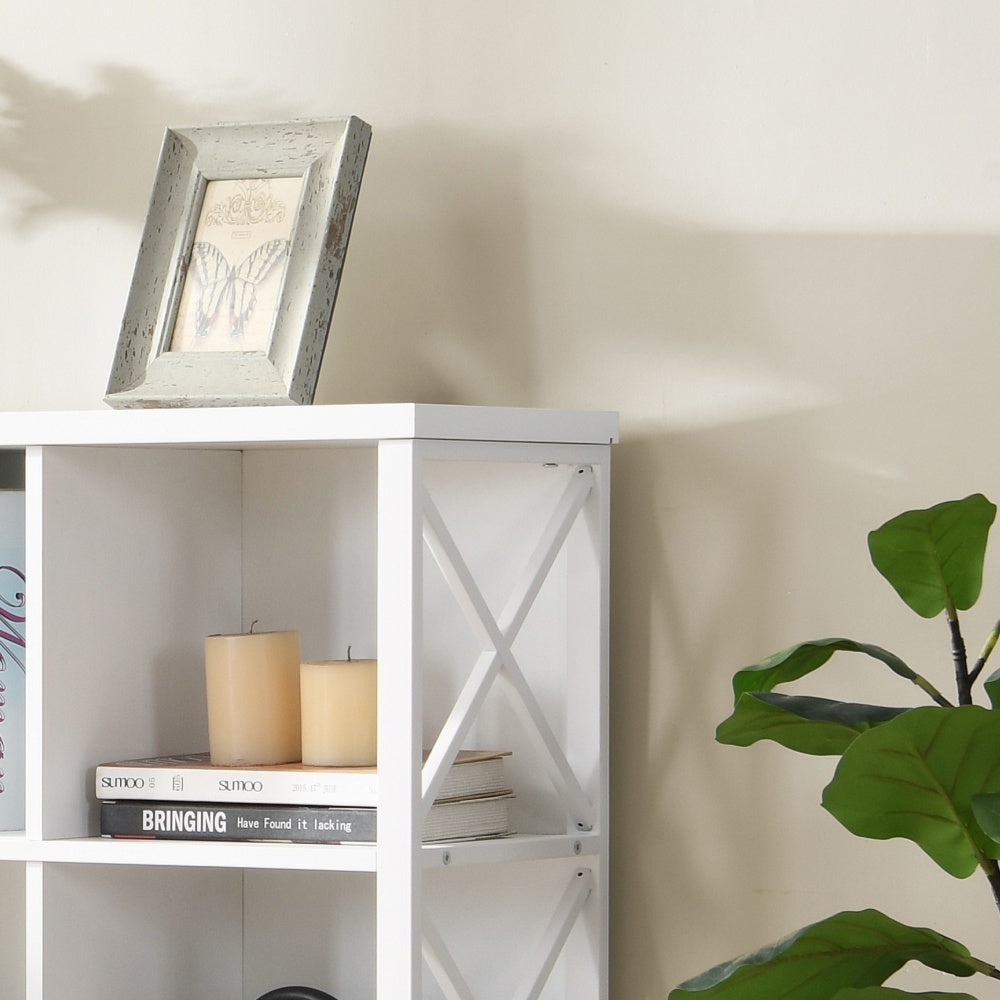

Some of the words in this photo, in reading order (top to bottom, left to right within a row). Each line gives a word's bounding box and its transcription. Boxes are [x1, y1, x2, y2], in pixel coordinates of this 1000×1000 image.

[142, 809, 227, 833] BRINGING
[237, 817, 259, 830] Have
[264, 817, 292, 831] Found
[298, 818, 308, 831] it
[314, 818, 352, 833] lacking
